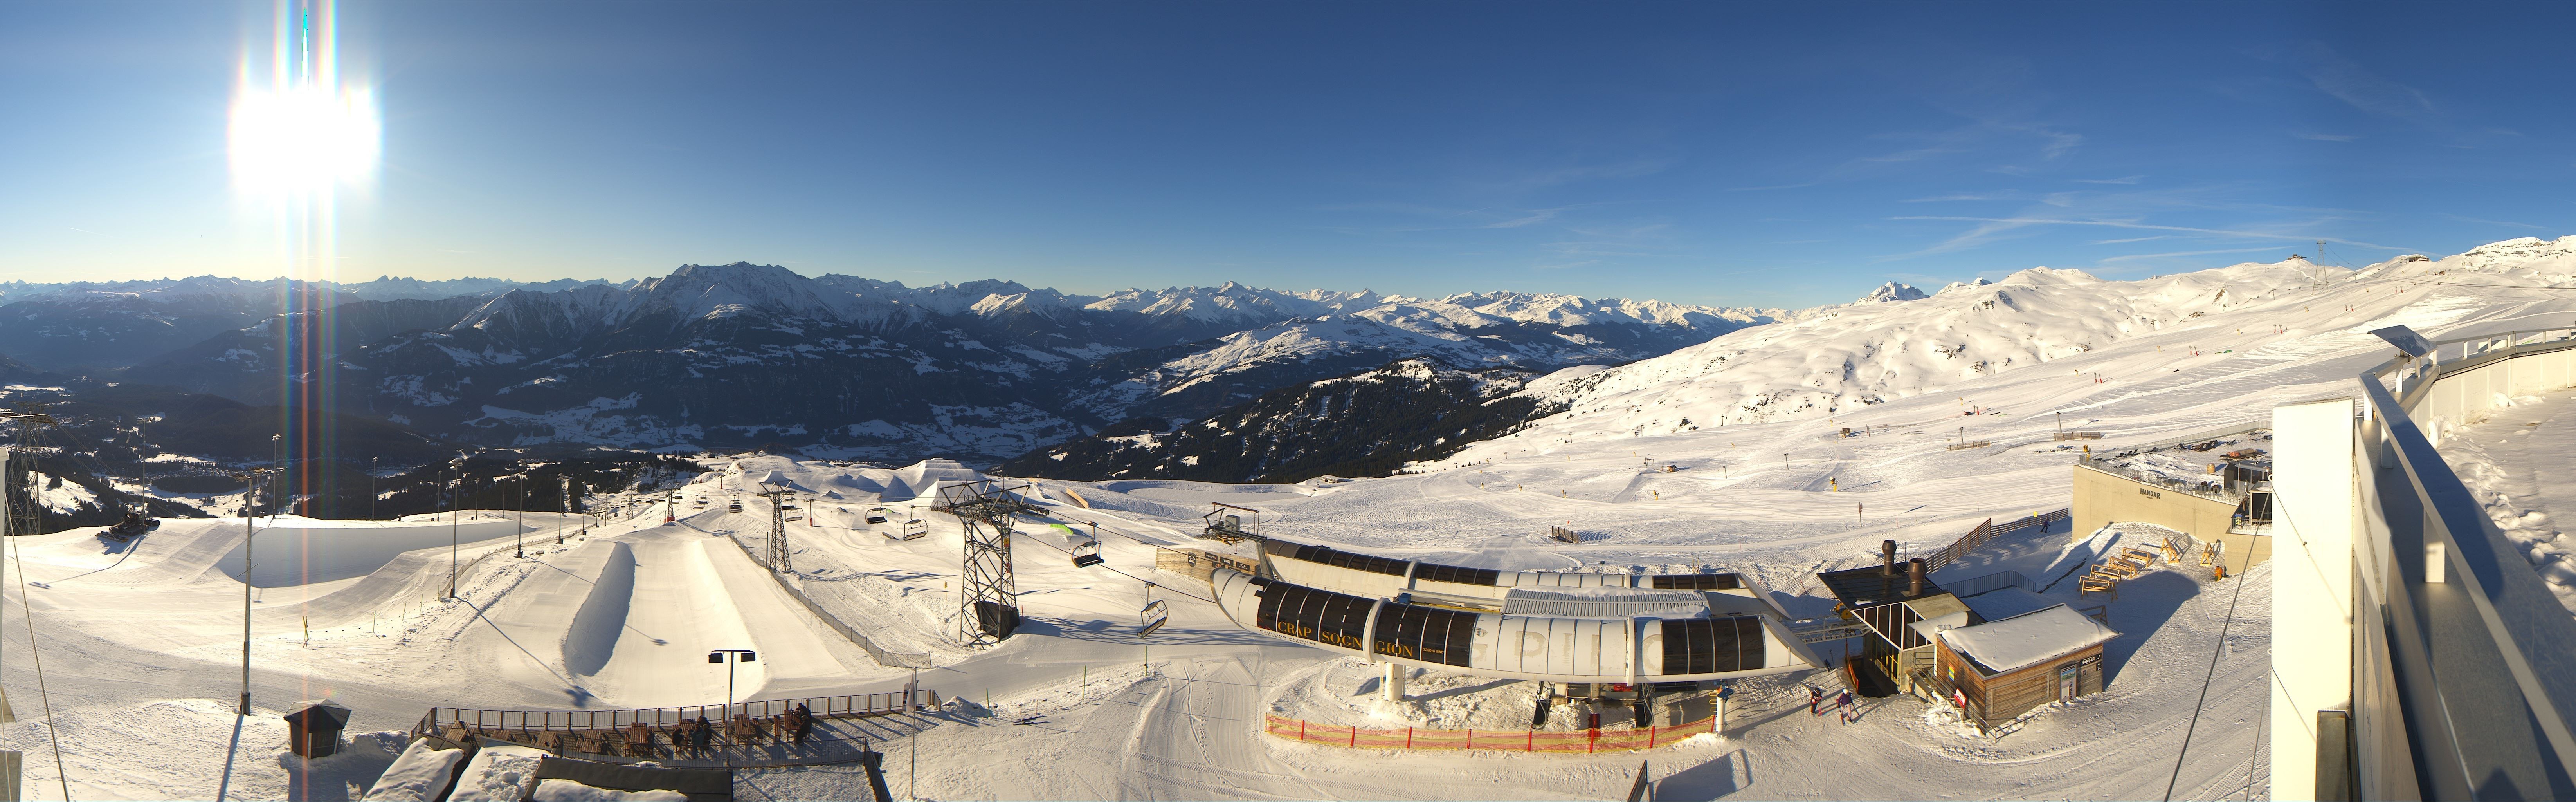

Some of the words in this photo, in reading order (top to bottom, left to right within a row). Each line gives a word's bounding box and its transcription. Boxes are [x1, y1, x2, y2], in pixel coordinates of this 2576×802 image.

[2140, 488, 2160, 499] HANGAR
[1278, 621, 1311, 637] CRAP
[1322, 631, 1363, 648] SOGN
[1375, 641, 1413, 657] GION
[1289, 637, 1317, 645] ALTITUDE
